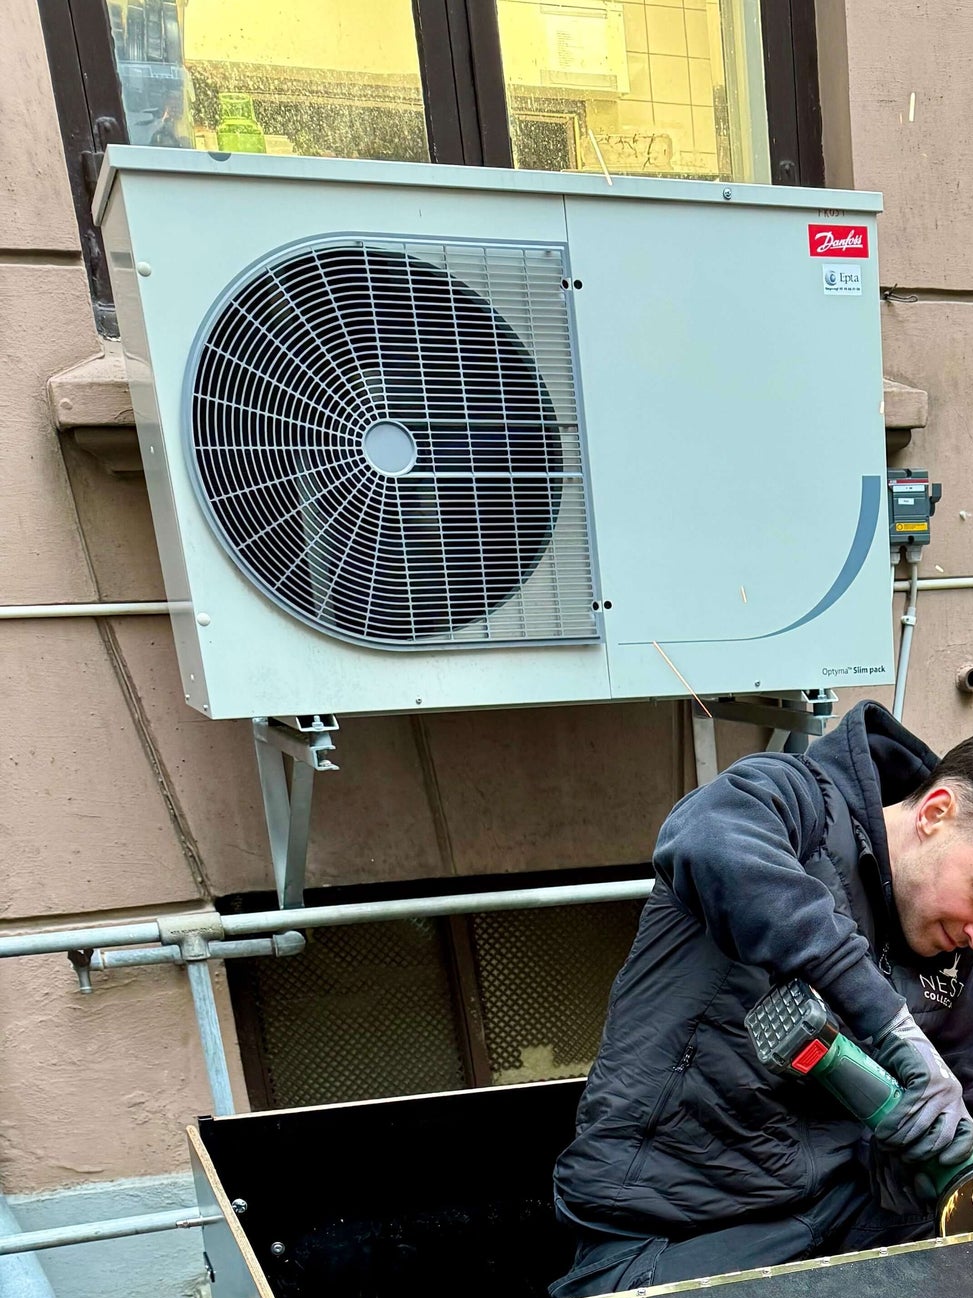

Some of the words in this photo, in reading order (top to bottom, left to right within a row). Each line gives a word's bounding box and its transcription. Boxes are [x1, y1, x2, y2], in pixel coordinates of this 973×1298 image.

[814, 229, 863, 252] Danfoss
[839, 273, 859, 284] Epta
[853, 666, 868, 674] Slim
[869, 665, 886, 675] pack
[919, 974, 965, 997] NEST
